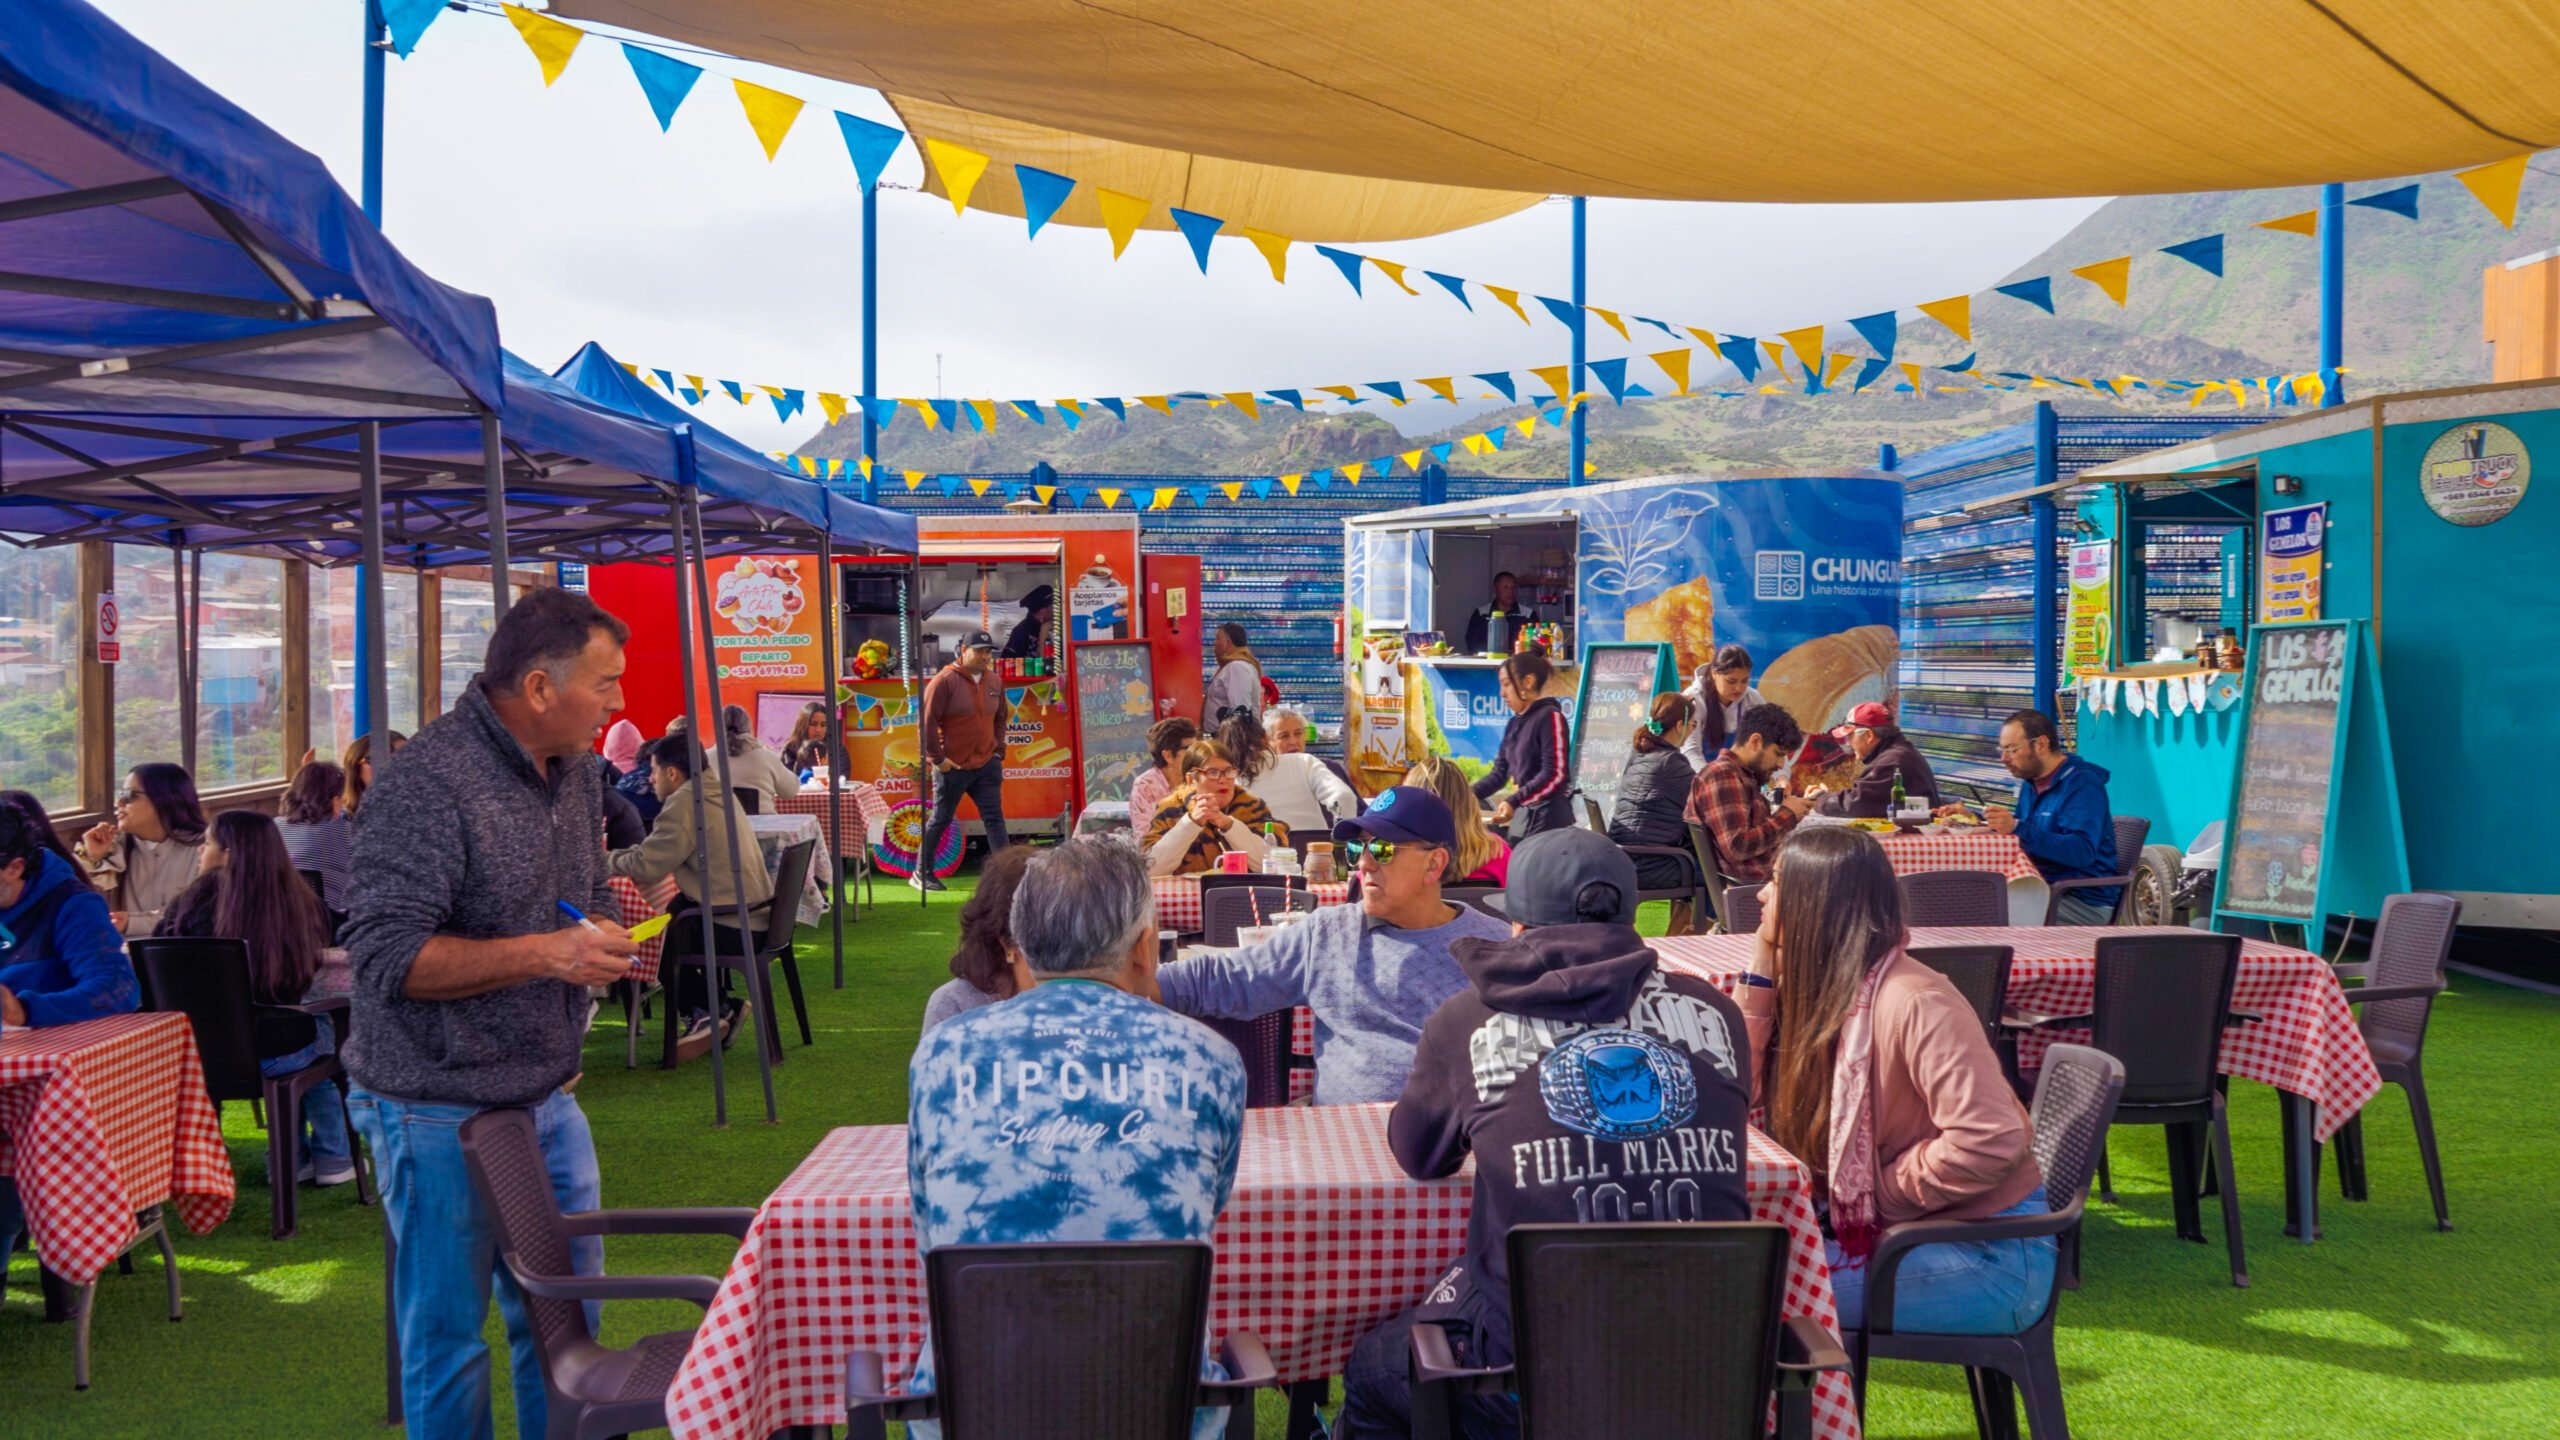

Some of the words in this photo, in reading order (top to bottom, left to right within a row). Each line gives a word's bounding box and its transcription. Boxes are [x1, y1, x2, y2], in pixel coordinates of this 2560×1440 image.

[2275, 516, 2292, 532] LOS
[1811, 585, 1833, 595] Una
[1833, 585, 1867, 596] historia
[1073, 591, 1117, 603] Aceptamos
[1073, 599, 1105, 607] tarjetas
[714, 636, 758, 646] TORTAS
[761, 637, 769, 645] A
[771, 635, 811, 645] PEDIDO
[741, 652, 790, 661] REPARTO
[2264, 633, 2308, 669] LOS
[731, 666, 756, 676] +569
[1008, 735, 1033, 744] PINO
[1003, 767, 1071, 778] CHAPARRITAS
[1033, 1028, 1061, 1039] MADE
[1084, 1027, 1120, 1040] WAVES
[994, 1113, 1110, 1152] Surfing
[1511, 1134, 1610, 1189] FULL
[1622, 1127, 1738, 1177] MARKS
[1571, 1177, 1700, 1224] 10-10
